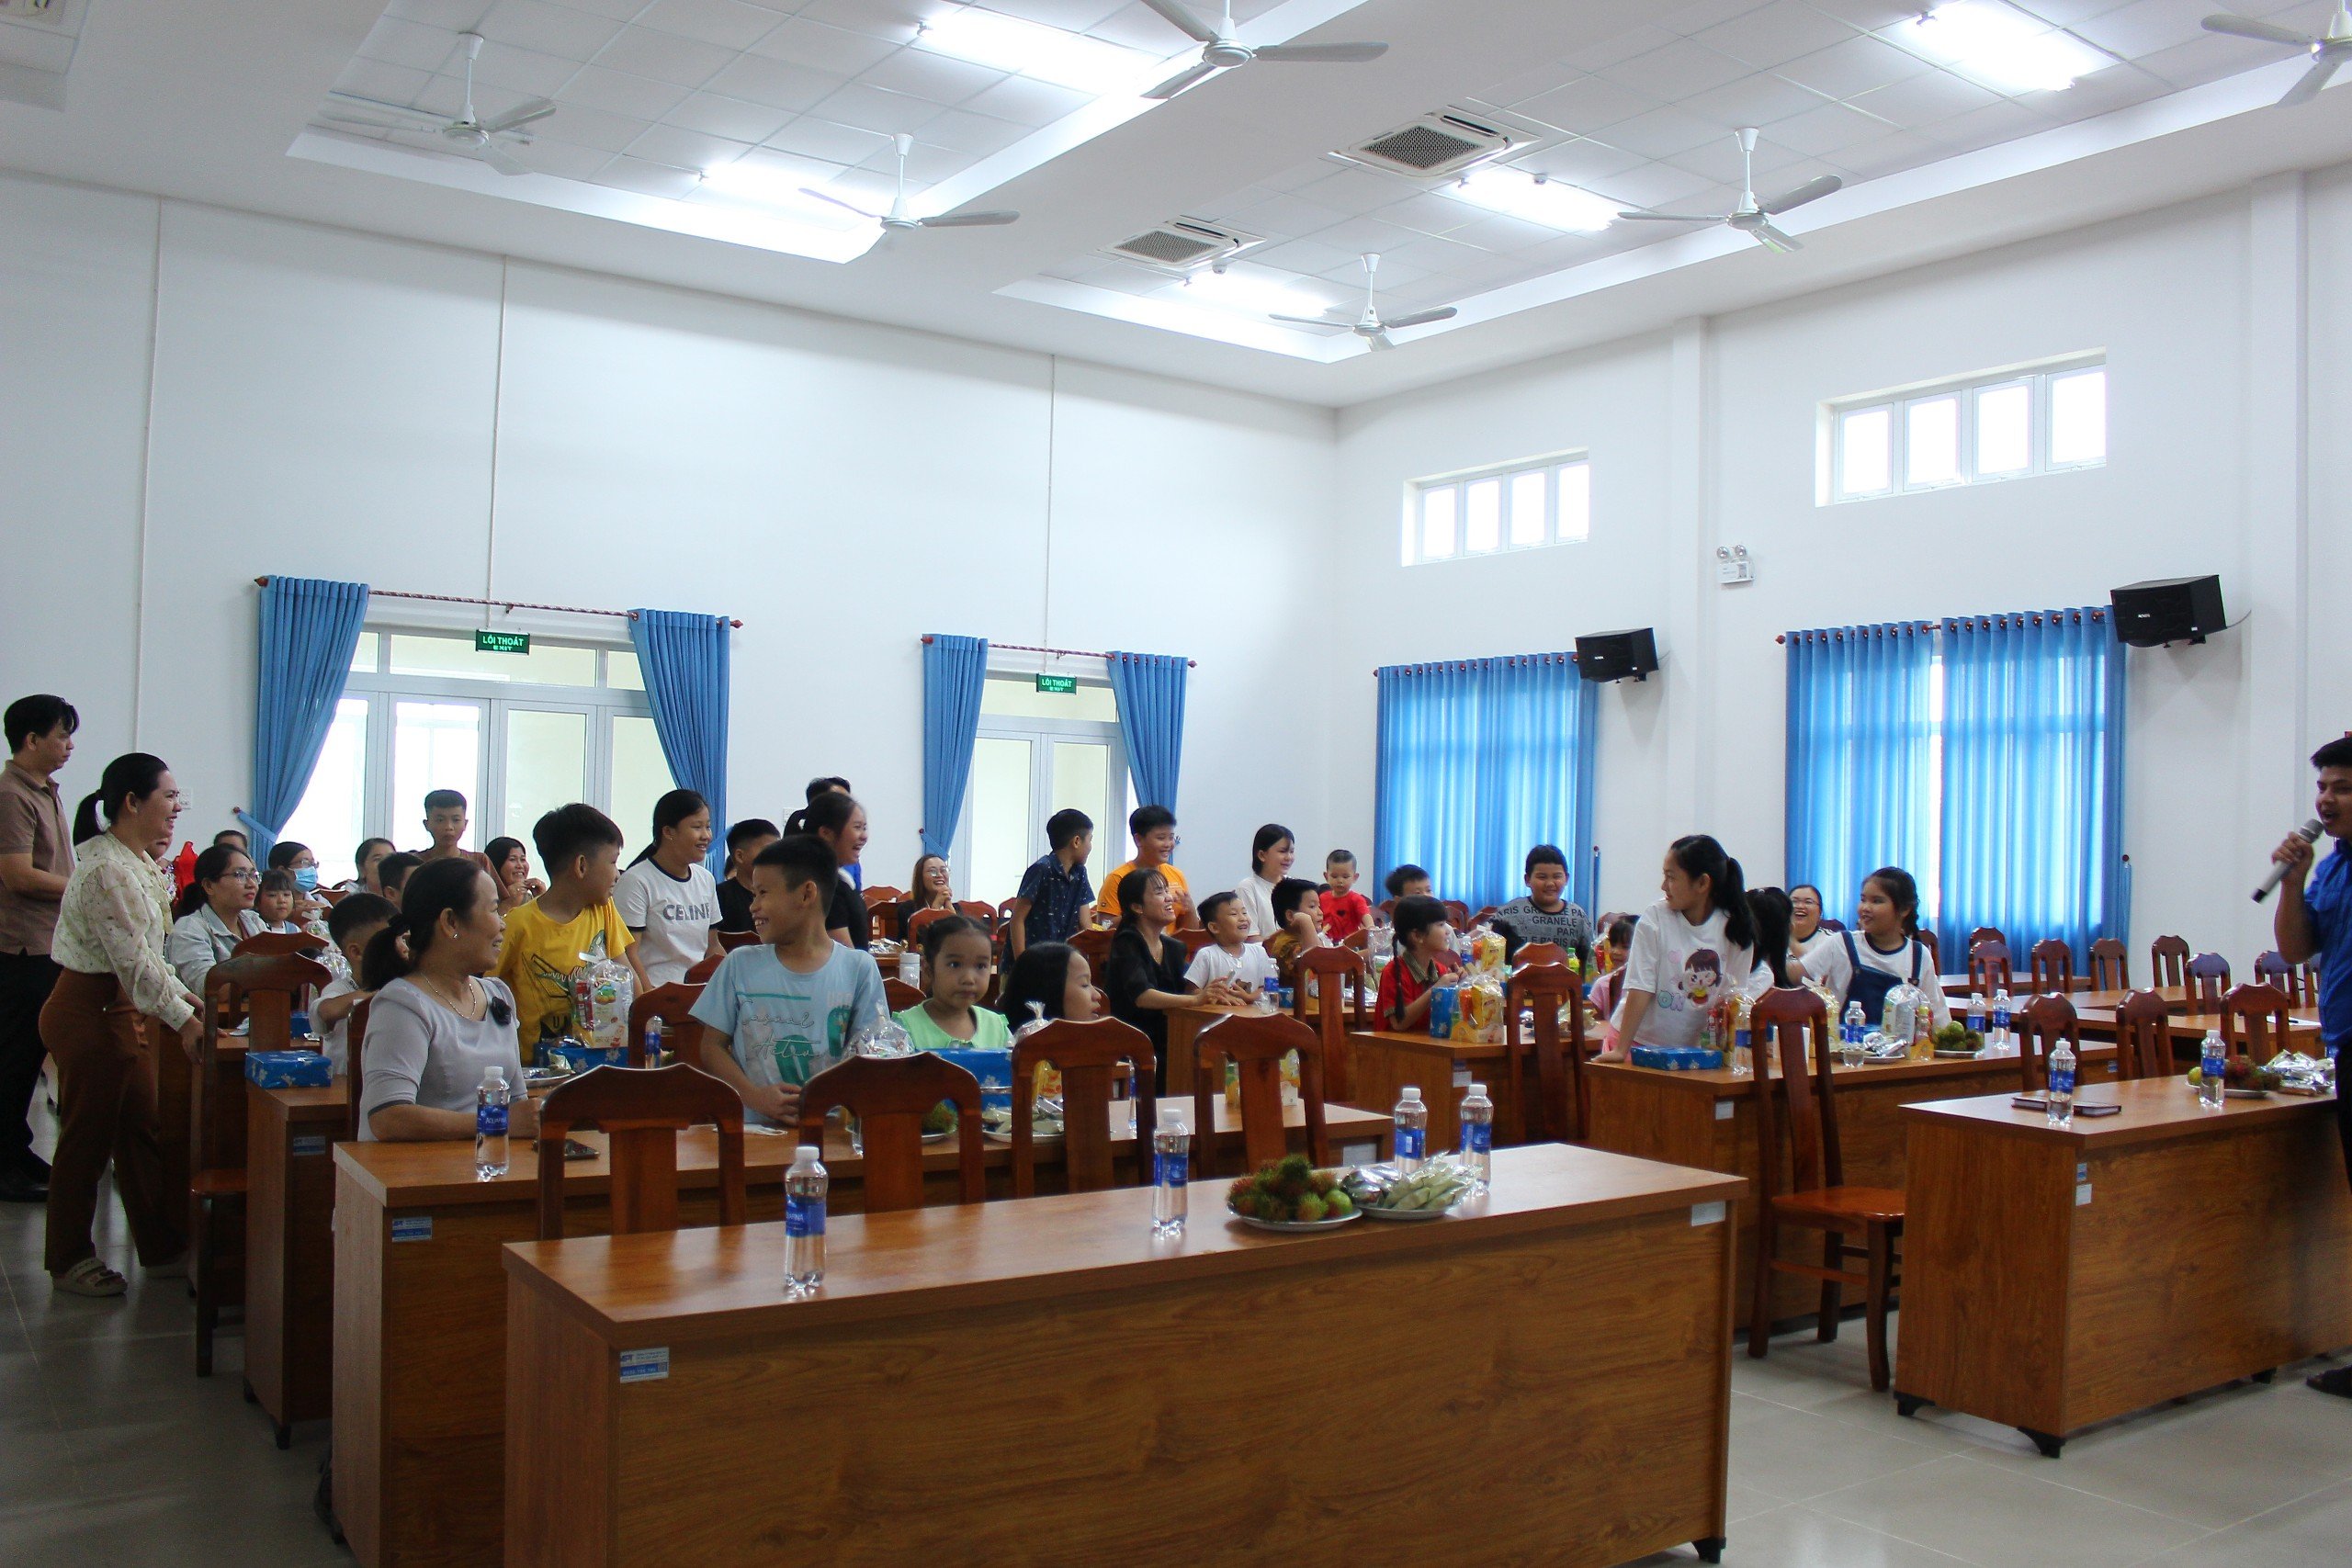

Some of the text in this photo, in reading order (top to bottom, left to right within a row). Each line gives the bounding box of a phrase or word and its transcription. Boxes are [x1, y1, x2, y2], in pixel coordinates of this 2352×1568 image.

[497, 636, 524, 647] THOÁT
[1053, 679, 1072, 687] THOÁT
[1532, 916, 1577, 928] GRANELE
